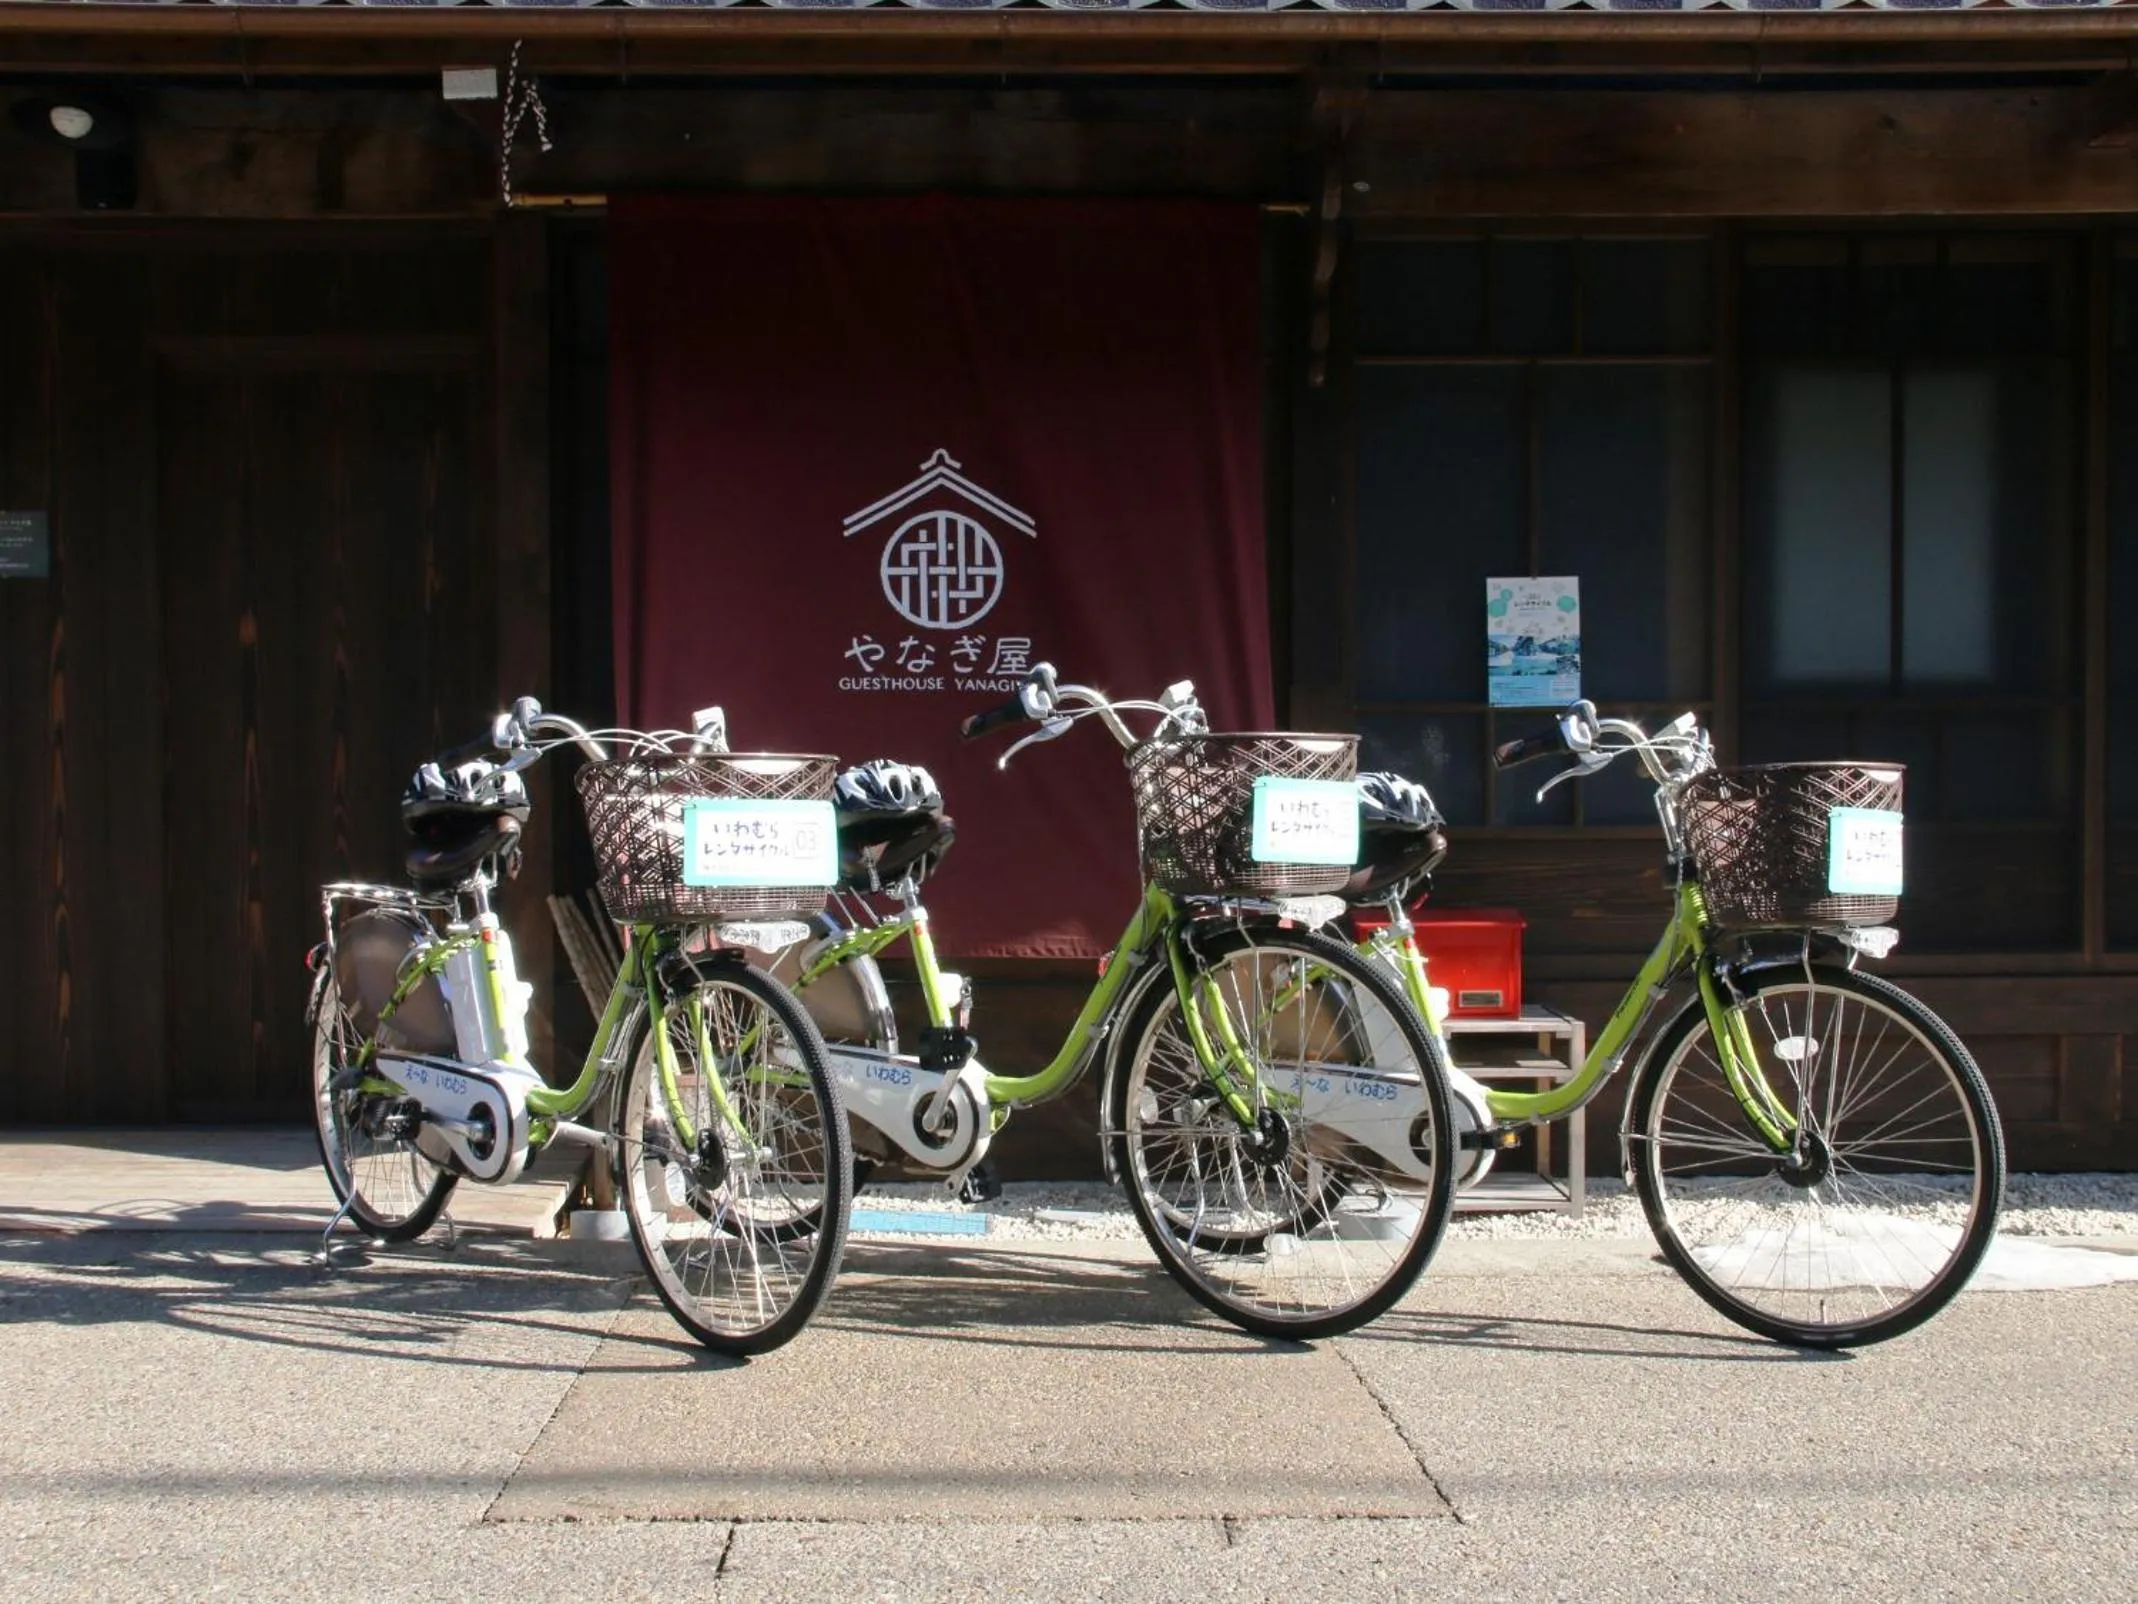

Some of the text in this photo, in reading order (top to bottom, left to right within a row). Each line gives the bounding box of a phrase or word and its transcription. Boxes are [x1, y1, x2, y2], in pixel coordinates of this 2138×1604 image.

[844, 634, 1031, 675] やなぎ屋
[838, 676, 945, 690] GUESTHOUSE
[865, 1063, 912, 1085] いわむら
[1345, 1080, 1398, 1100] いわむら
